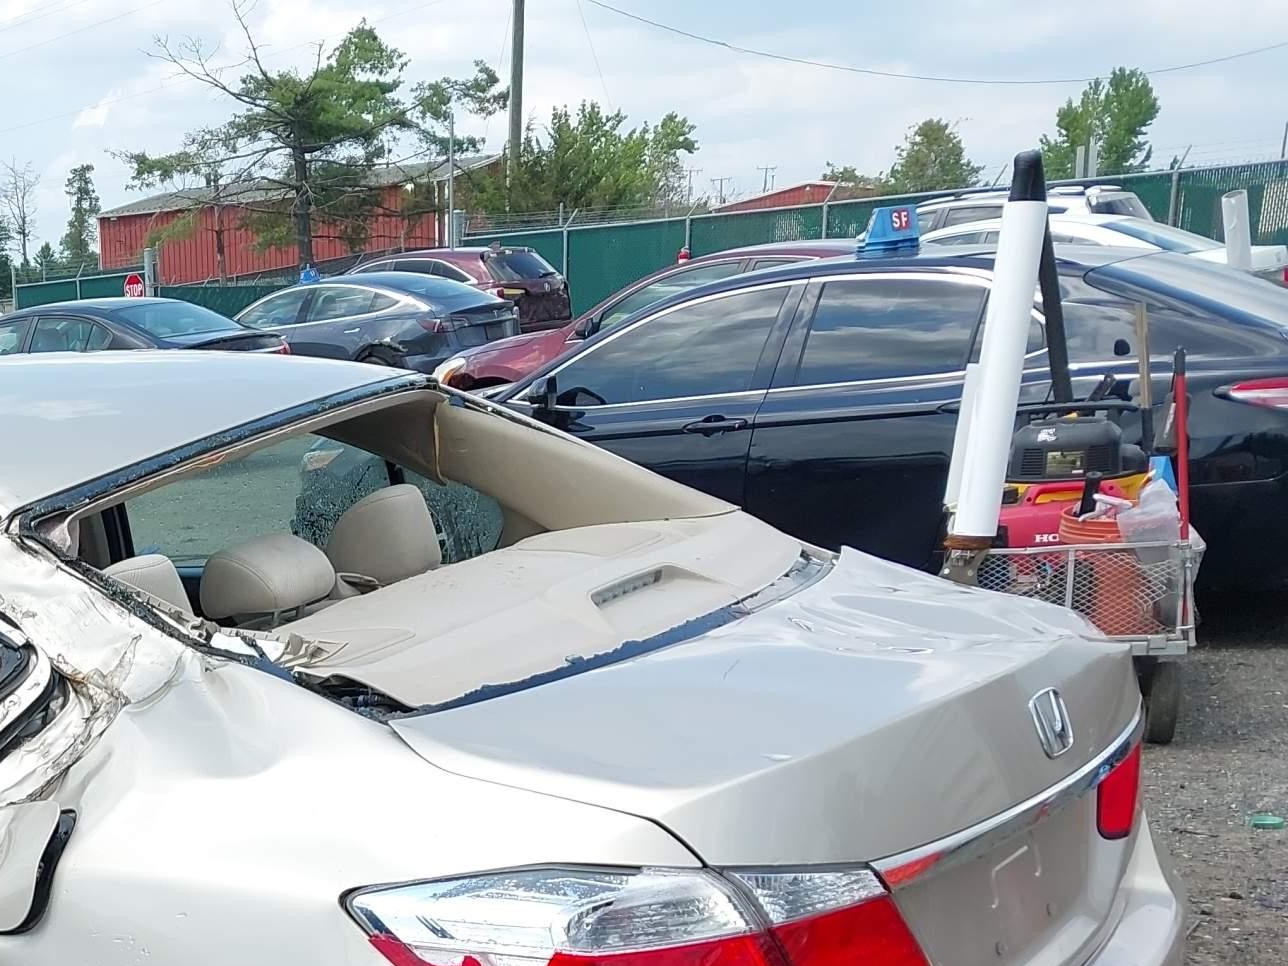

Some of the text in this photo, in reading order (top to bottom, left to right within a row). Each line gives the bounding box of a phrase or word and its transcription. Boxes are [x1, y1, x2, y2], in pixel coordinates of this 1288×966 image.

[892, 211, 909, 228] SF
[125, 284, 143, 297] STOP
[1033, 533, 1060, 543] HO
